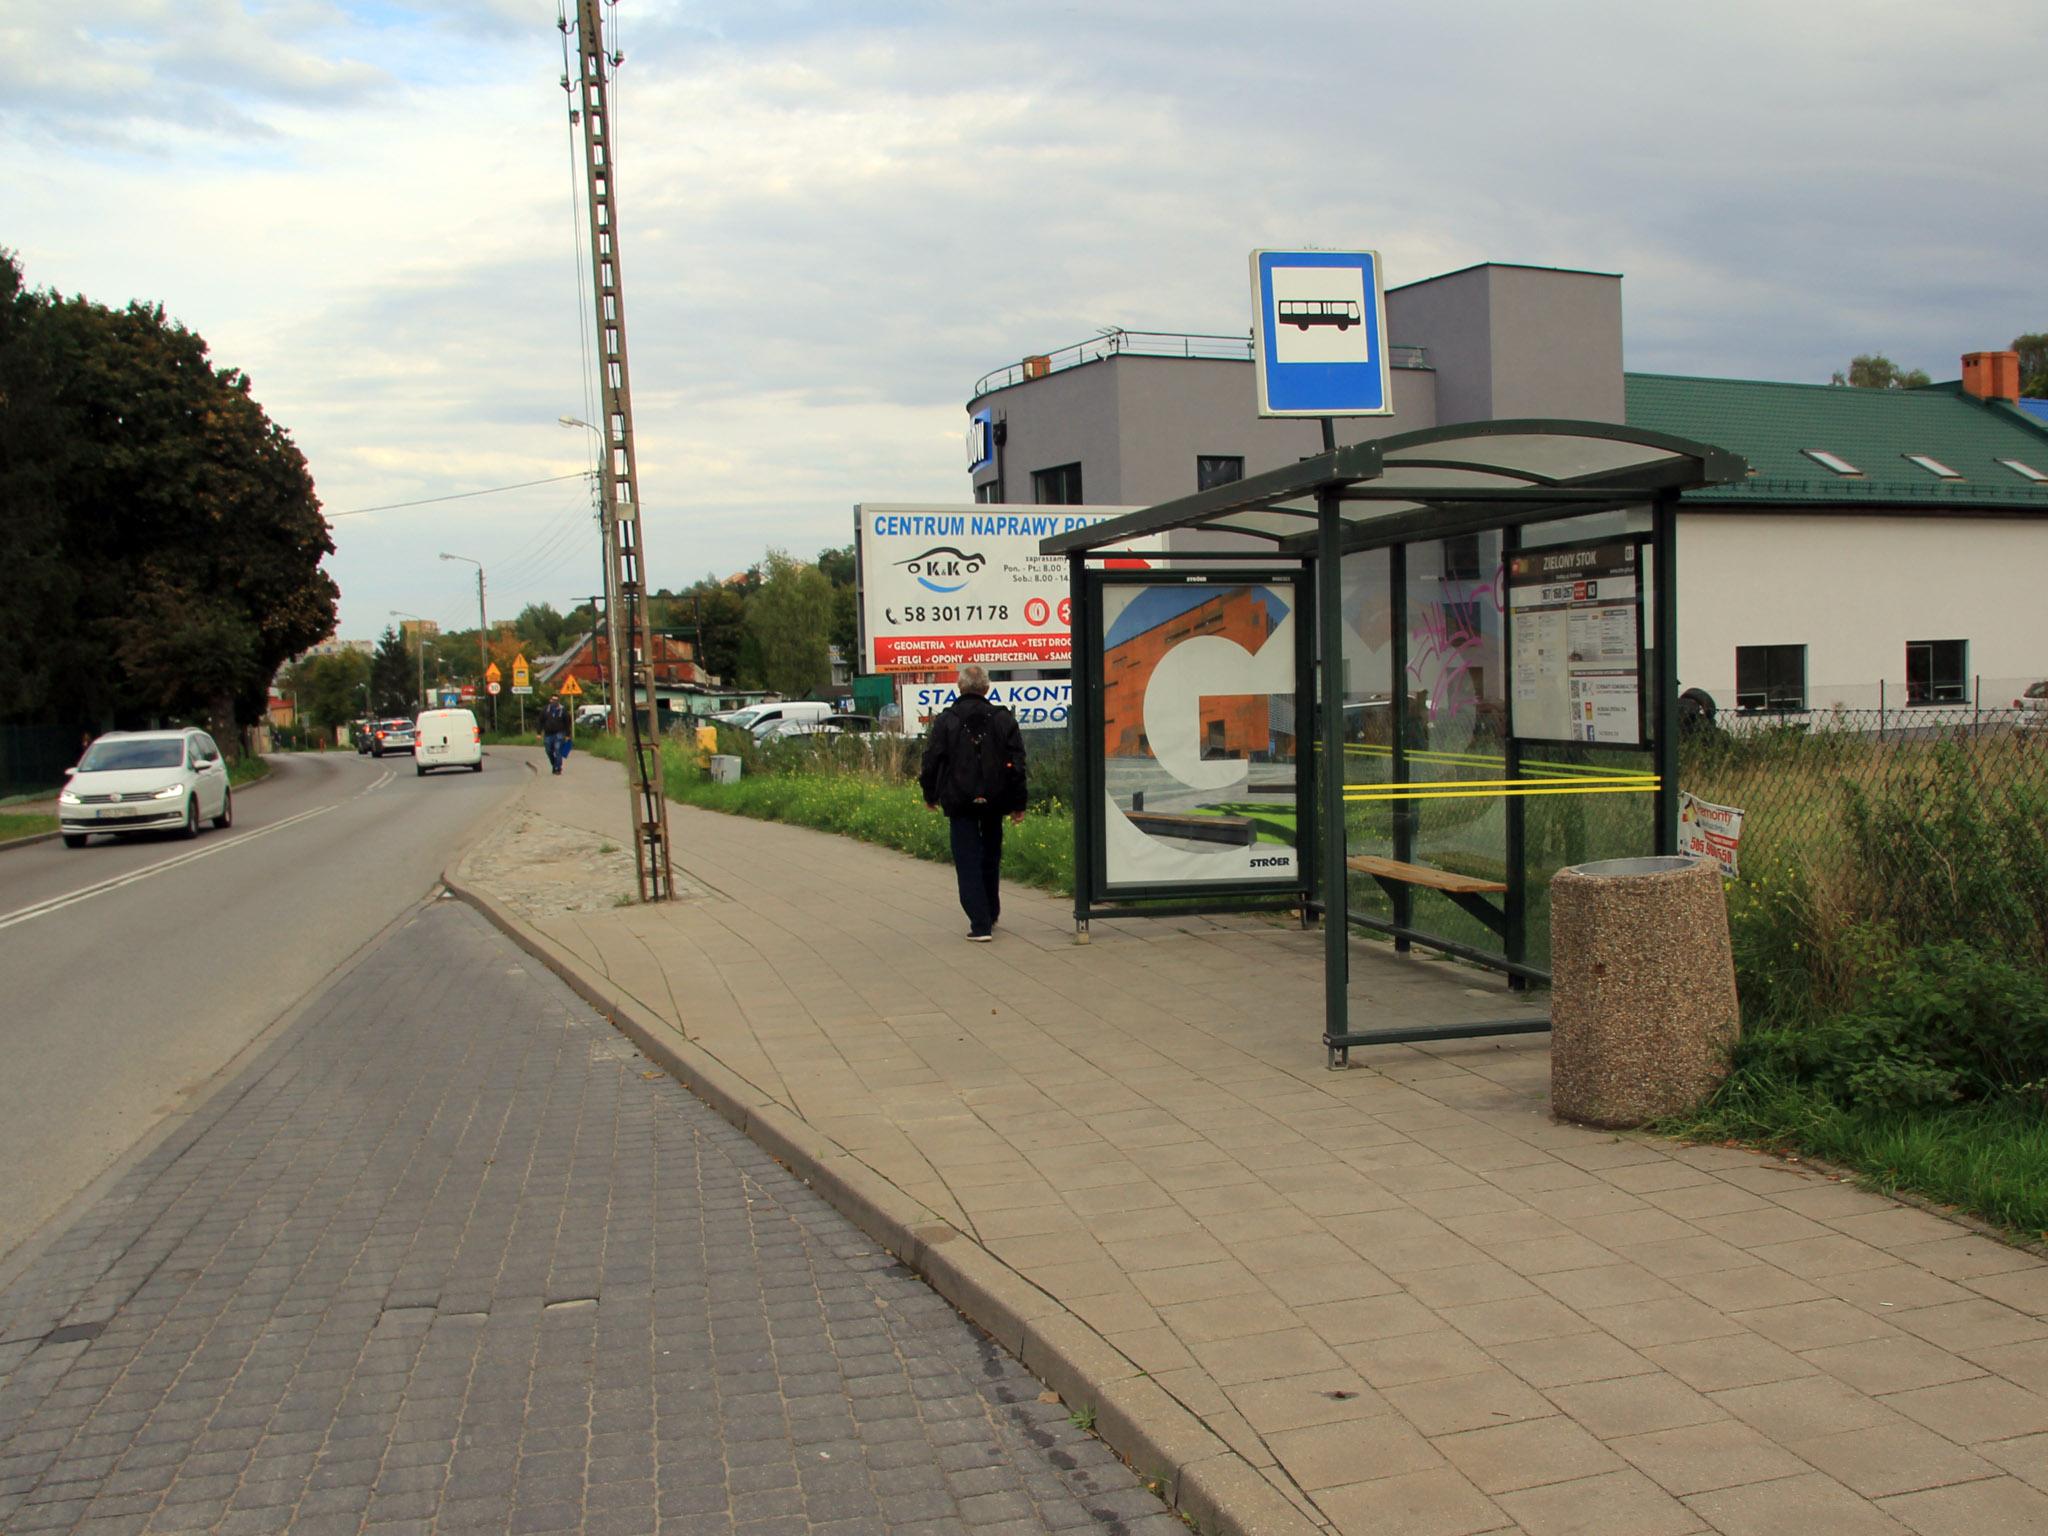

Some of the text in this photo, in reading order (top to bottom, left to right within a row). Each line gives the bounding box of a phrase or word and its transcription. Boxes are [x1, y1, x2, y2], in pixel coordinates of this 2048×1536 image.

[875, 516, 964, 536] CENTRUM
[971, 516, 1058, 536] NAPRAWY
[1003, 564, 1020, 572] Pon.
[1043, 564, 1062, 572] 8.00
[1543, 551, 1597, 570] ZIELONY STOK
[1035, 574, 1053, 582] 8.00
[905, 605, 1008, 621] 58 301 71 78
[894, 641, 945, 650] GEOMETRIA
[955, 639, 1018, 649] KLIMATYZACJA
[1028, 638, 1047, 647] TEST
[897, 656, 921, 664] FELGI
[931, 654, 964, 663] OPONY
[973, 652, 1039, 662] UBEZPIECZENIA
[918, 686, 1072, 705] STAA KONT
[1019, 702, 1069, 724] ZDÓ
